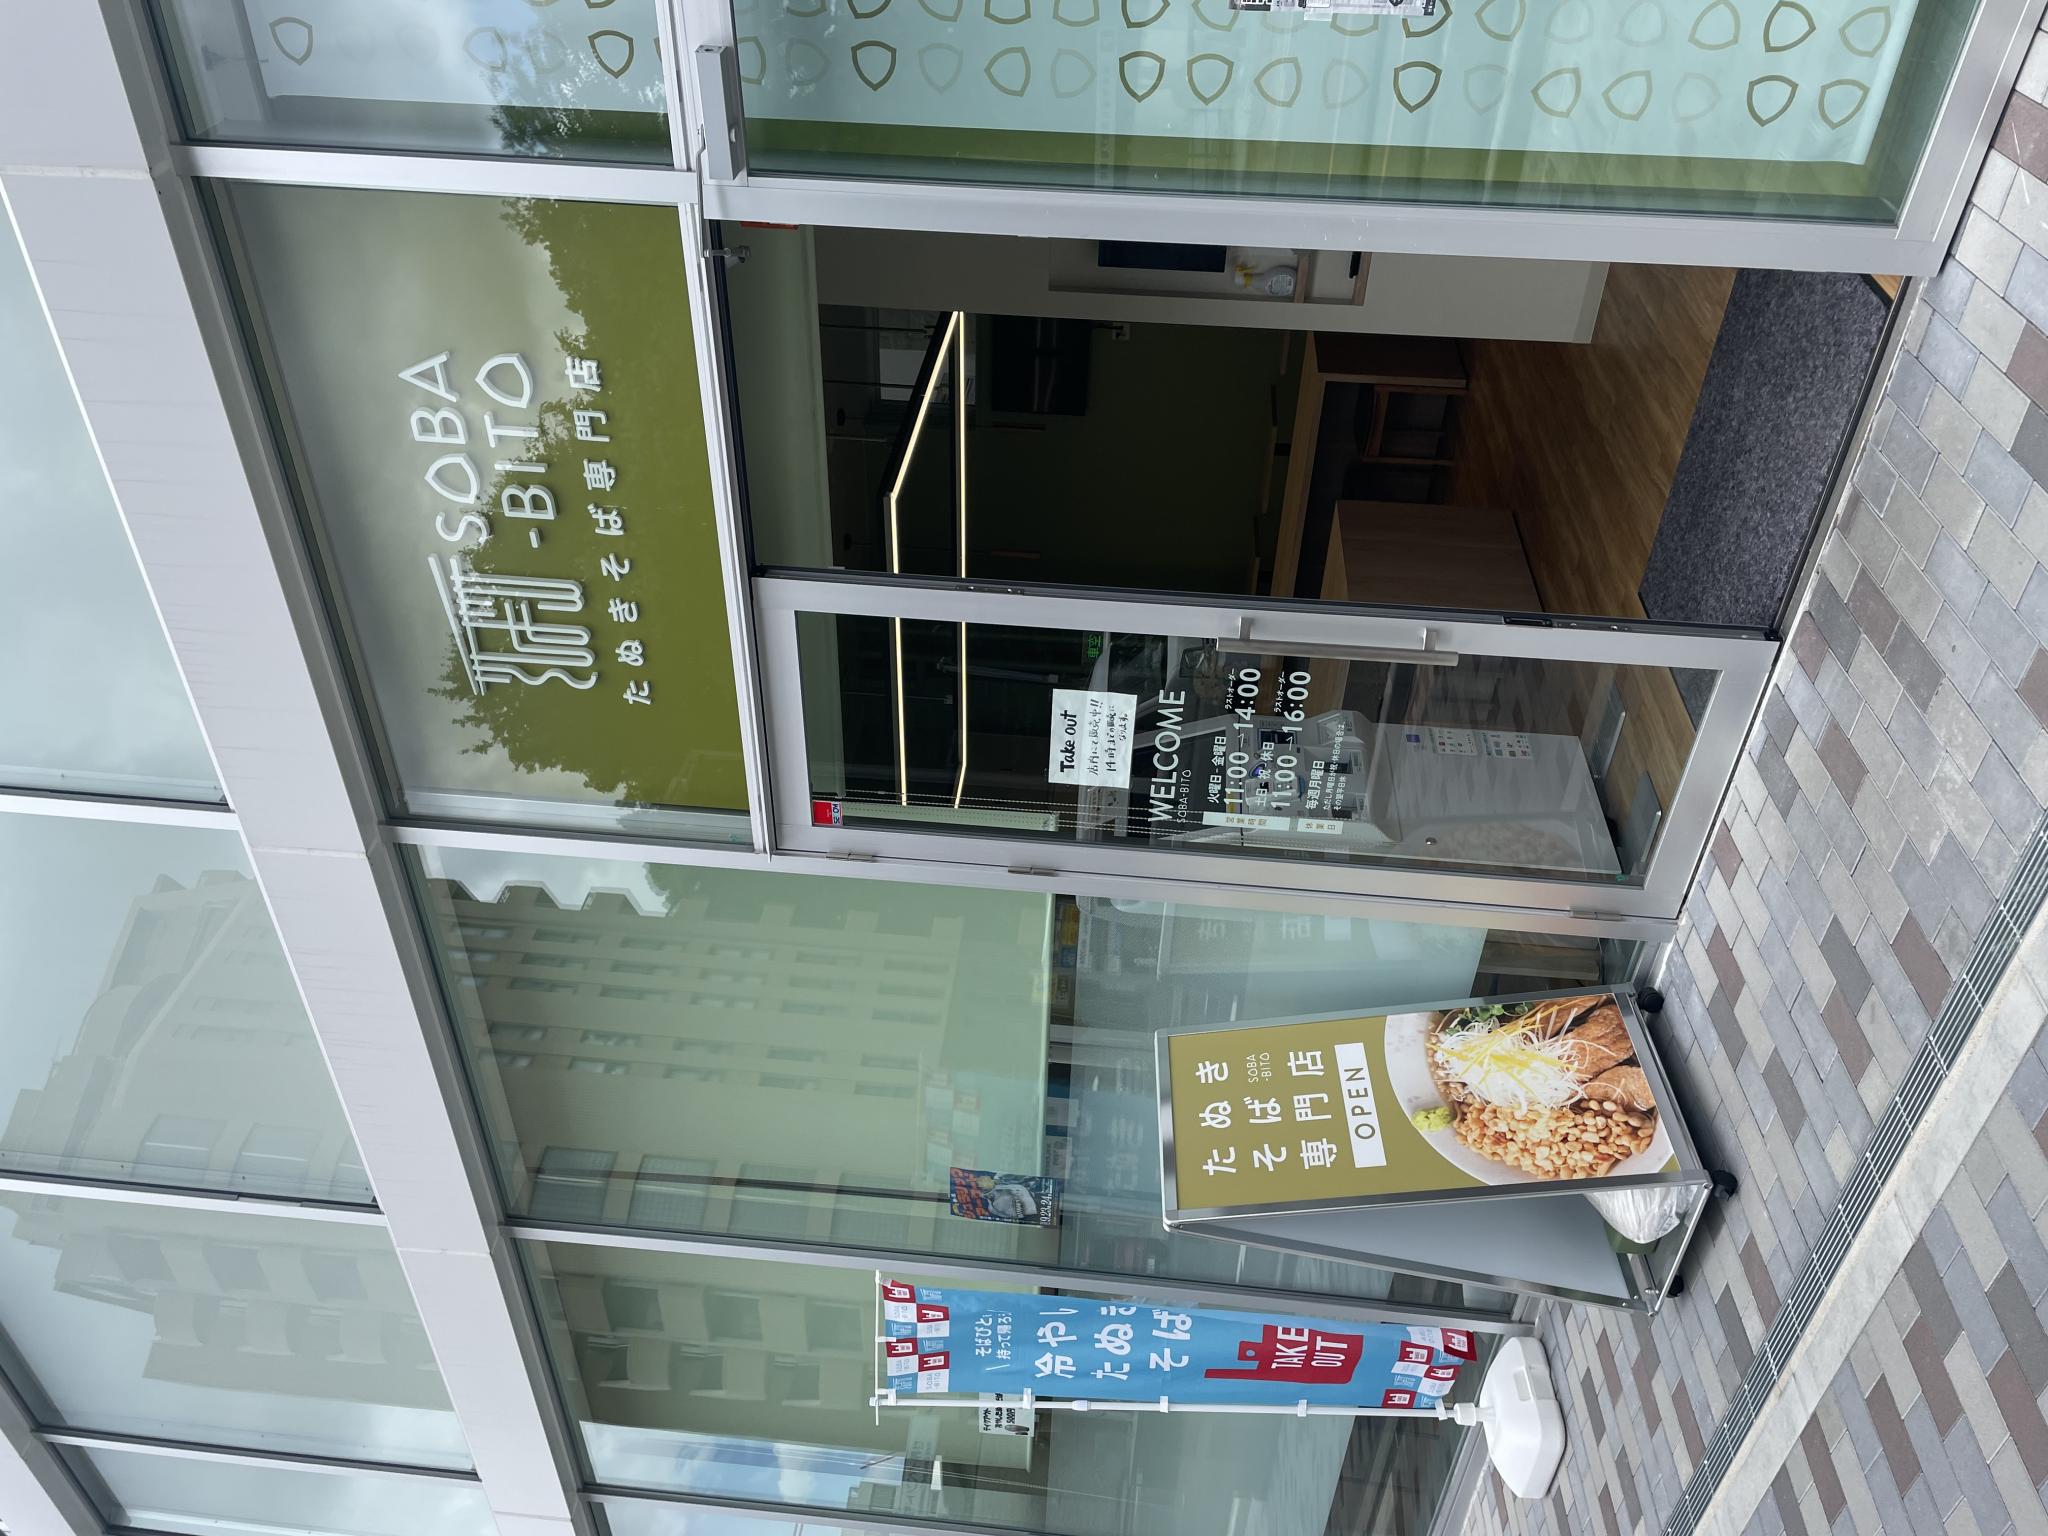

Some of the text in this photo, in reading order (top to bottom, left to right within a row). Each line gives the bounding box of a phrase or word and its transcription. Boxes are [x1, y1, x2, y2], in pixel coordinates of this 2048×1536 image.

[398, 351, 490, 544] SOBA
[474, 353, 557, 549] -BITO
[564, 357, 652, 705] たぬきそば専門店
[1224, 667, 1236, 711] ラストオーダー
[1274, 670, 1285, 714] ラストオーダー
[1059, 709, 1078, 773] Take out
[1147, 689, 1186, 822] WELCOME
[1223, 667, 1262, 805] 11:00 14:00
[1270, 670, 1312, 809] 11:00 16:00
[1177, 769, 1192, 824] SOBA-BITO
[1304, 760, 1326, 810] 毎週月曜日
[1246, 1053, 1259, 1083] SOBA
[1343, 1066, 1376, 1140] OPEN
[1194, 1060, 1237, 1176] たぬき
[1243, 1096, 1287, 1172] そば
[1287, 1050, 1338, 1170] 専門店
[1149, 1309, 1193, 1372] そば
[1270, 1325, 1309, 1369] TAKE
[1310, 1336, 1348, 1367] OUT
